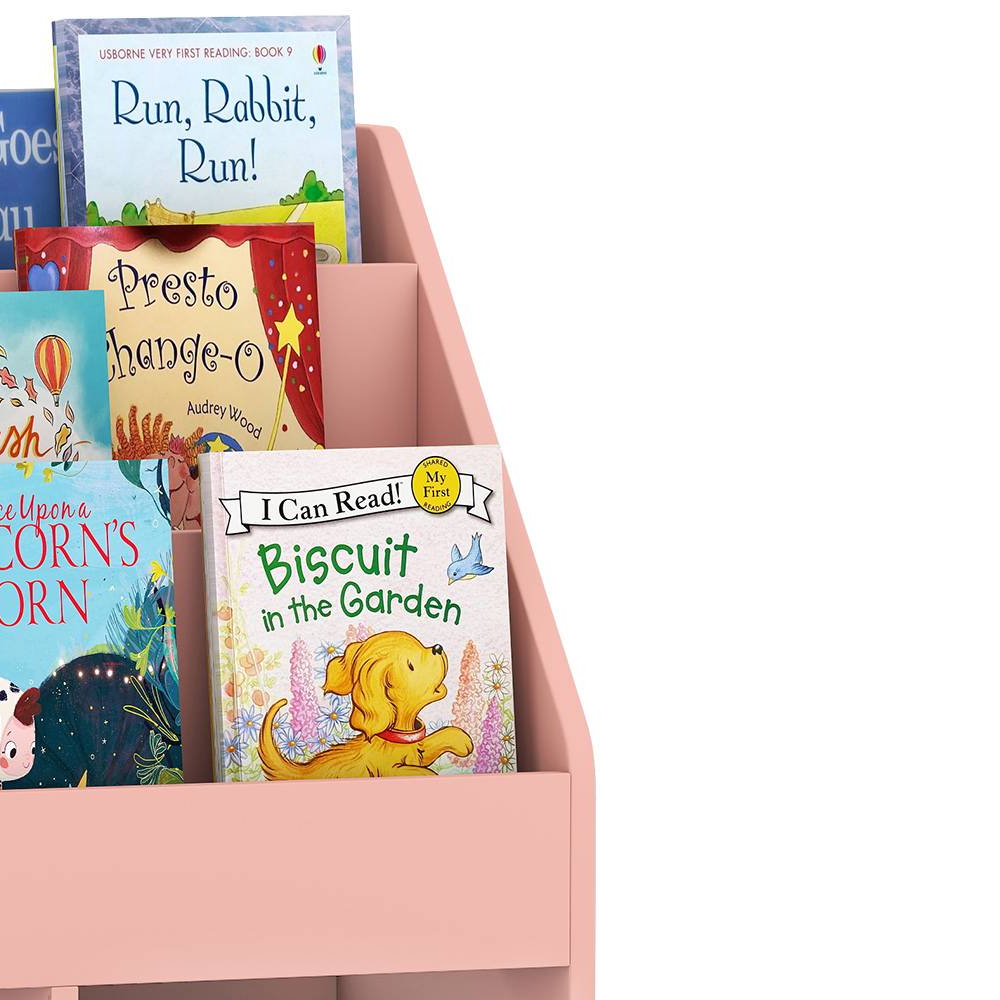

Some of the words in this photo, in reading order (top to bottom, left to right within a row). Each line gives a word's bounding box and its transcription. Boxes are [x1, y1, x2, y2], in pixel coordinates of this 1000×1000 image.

[100, 48, 145, 60] USBORNE
[149, 48, 173, 60] VERY
[176, 48, 201, 59] FIRST
[204, 47, 251, 59] READING:
[254, 46, 284, 58] BOOK
[287, 46, 294, 57] 9
[112, 80, 191, 131] Run,
[202, 75, 316, 129] Rabbit,
[178, 138, 258, 184] Run!
[108, 259, 239, 311] Presto
[106, 327, 264, 384] hange-O
[187, 400, 227, 420] Audrey
[229, 404, 263, 440] Wood
[422, 459, 449, 469] SHARED
[425, 471, 447, 486] My
[261, 499, 271, 521] I
[278, 498, 329, 521] Can
[333, 482, 401, 516] Read!
[423, 486, 450, 498] First
[423, 500, 452, 512] READING
[20, 494, 73, 538] Upon
[74, 502, 92, 520] a
[257, 533, 418, 595] Biscuit
[261, 607, 285, 632] in
[288, 595, 333, 624] the
[340, 581, 462, 625] Garden
